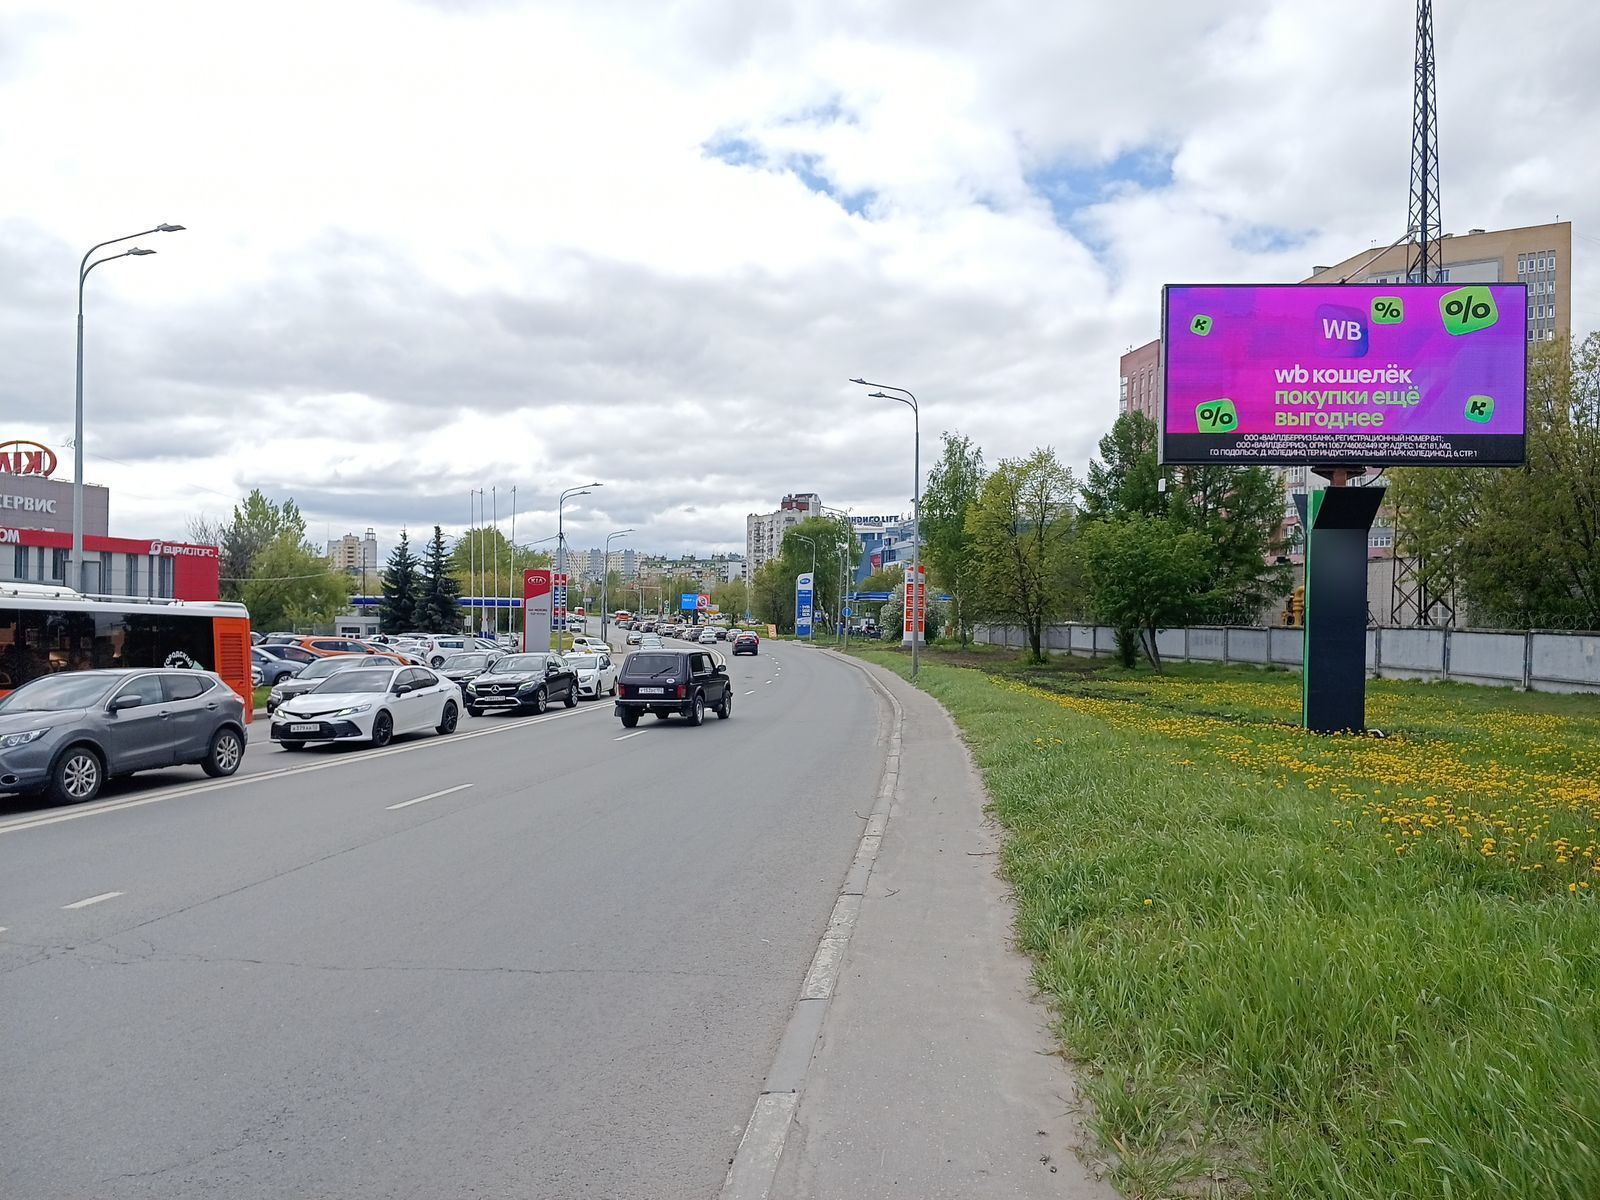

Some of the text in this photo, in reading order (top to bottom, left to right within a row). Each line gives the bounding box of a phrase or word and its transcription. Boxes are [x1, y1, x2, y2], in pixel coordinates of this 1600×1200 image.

[1322, 318, 1362, 341] WB
[1275, 364, 1412, 384] wb кошелёк
[1275, 386, 1420, 410] покупки ещё
[1275, 412, 1384, 430] выгоднее
[1335, 434, 1404, 442] РЕГИСТРАЦИОННЫЙ
[0, 494, 57, 514] ЕРВИС
